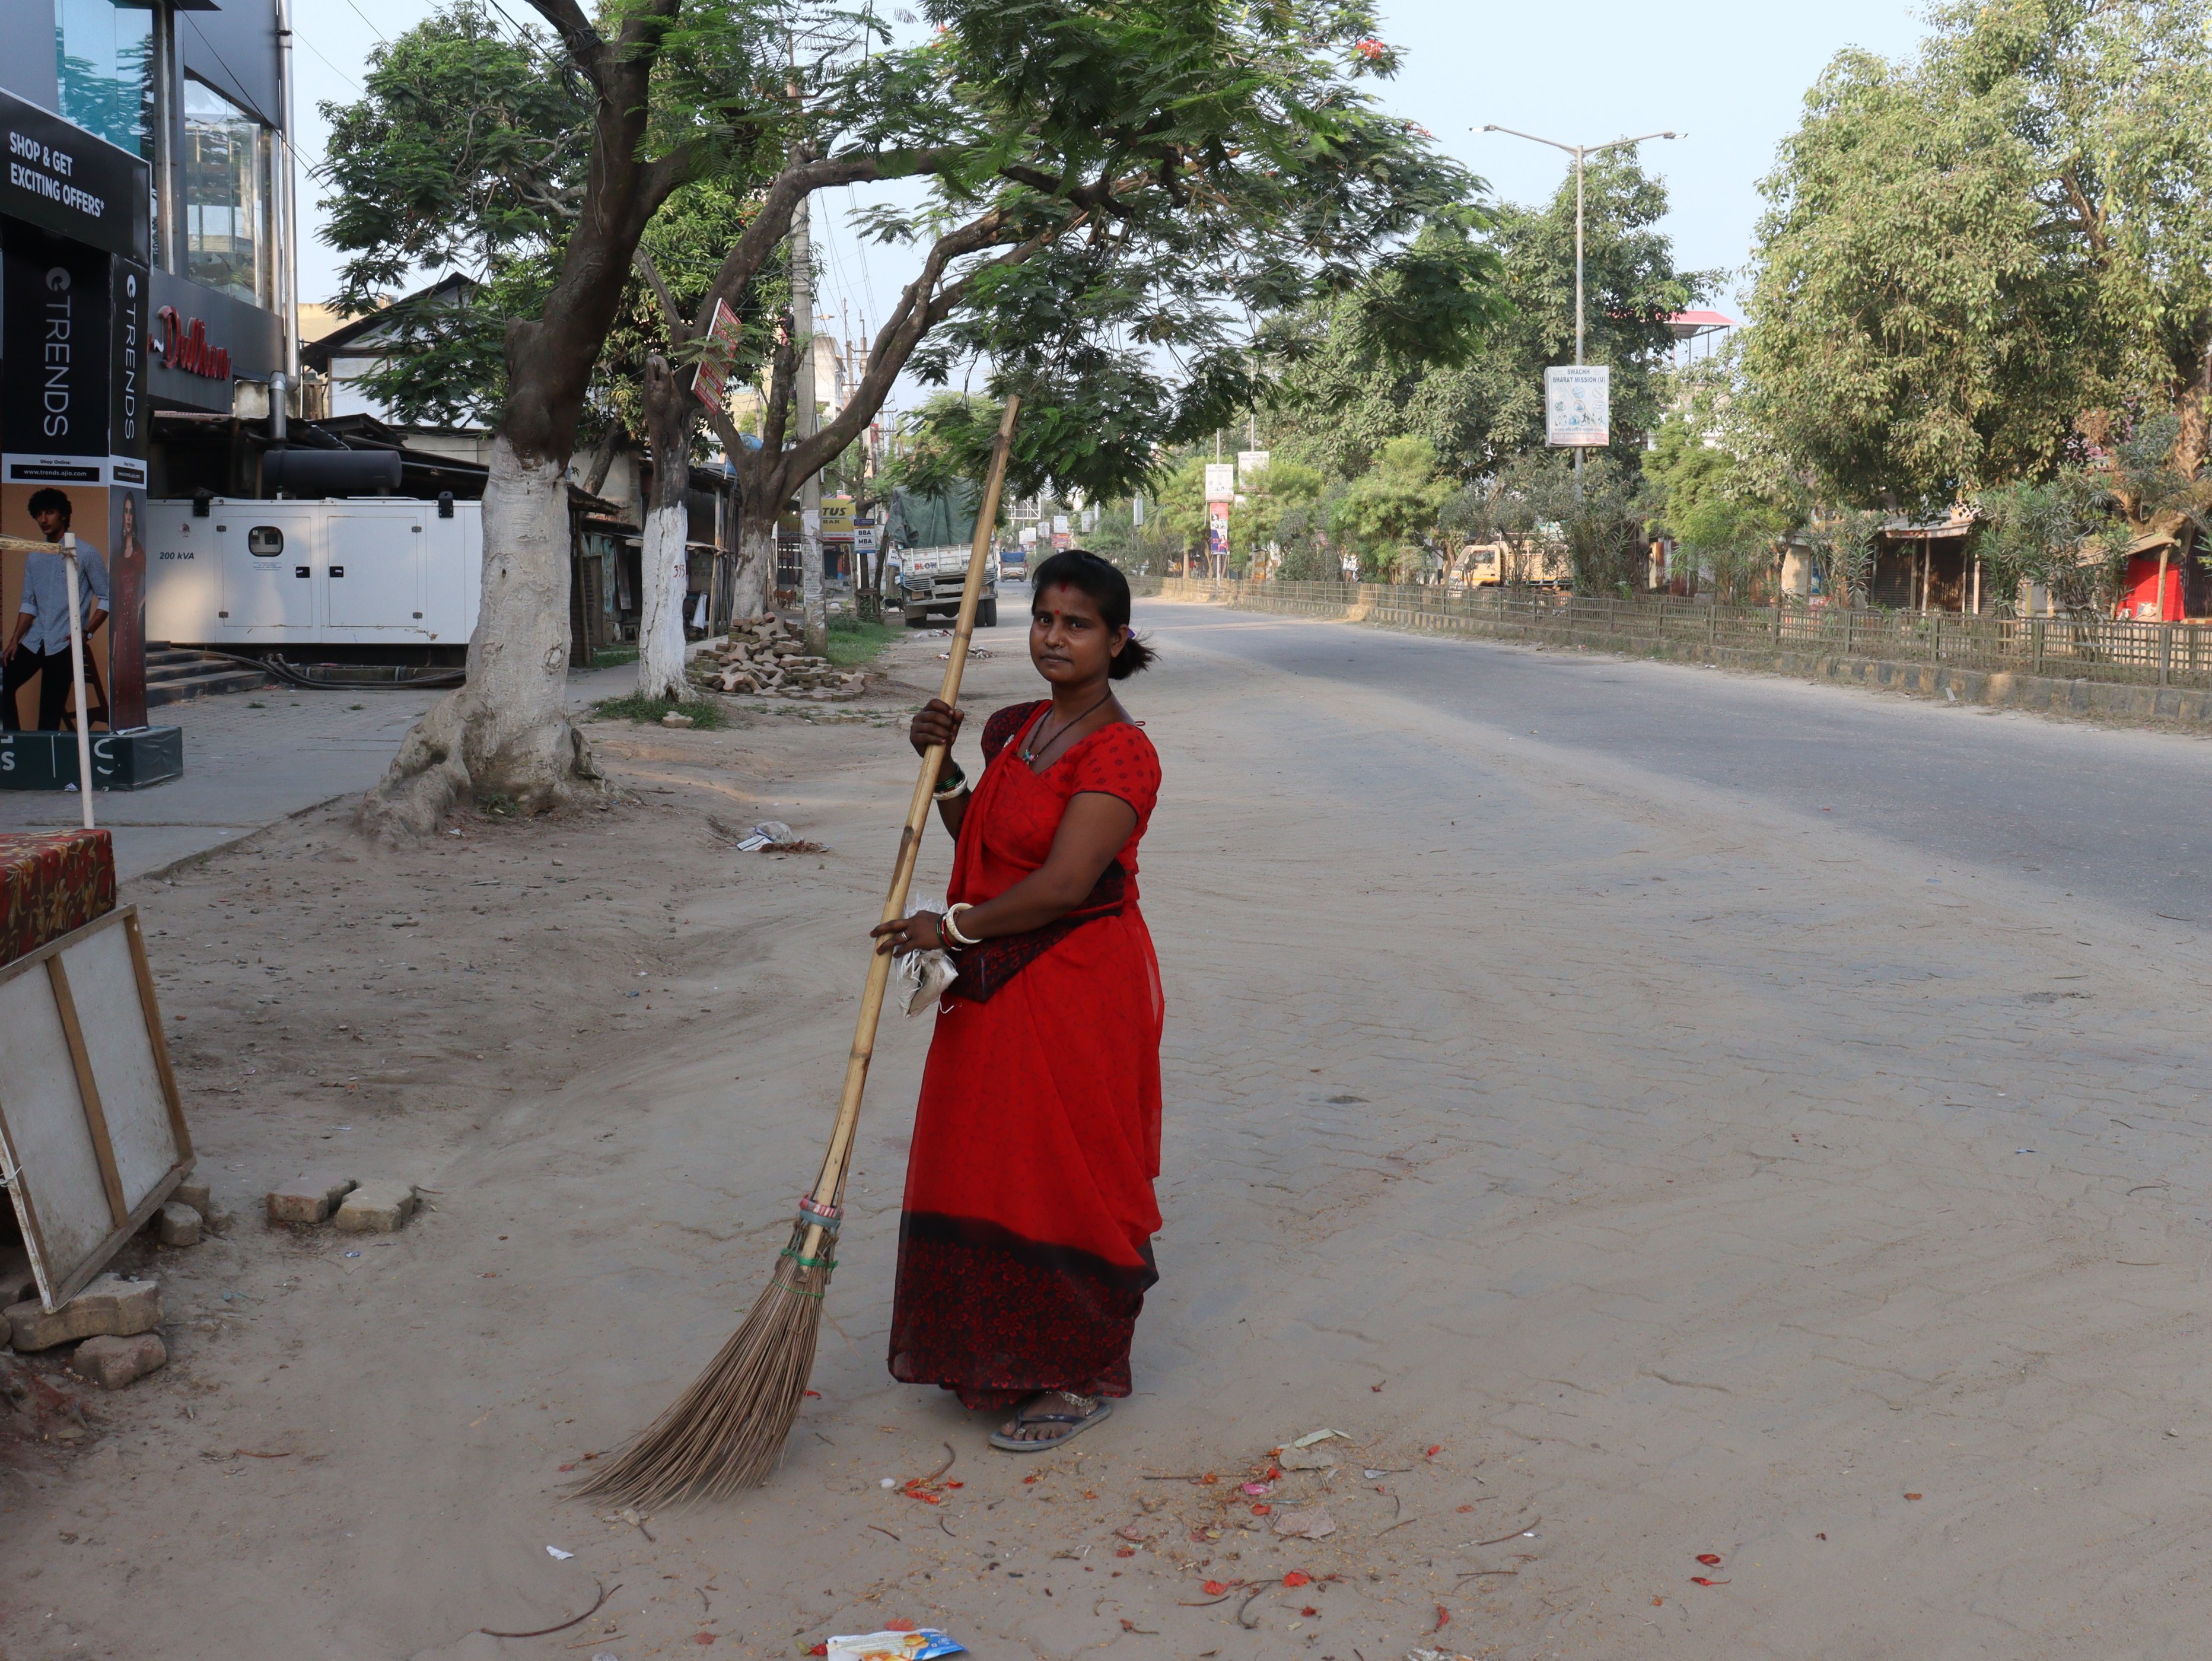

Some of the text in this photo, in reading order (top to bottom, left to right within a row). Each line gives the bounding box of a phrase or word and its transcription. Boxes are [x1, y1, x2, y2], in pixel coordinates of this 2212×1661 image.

[9, 131, 73, 177] SHOP & GET
[11, 162, 61, 201] EXCITING
[44, 295, 71, 436] TRENDS
[125, 303, 136, 439] TRENDS
[822, 507, 846, 516] TUS
[914, 562, 937, 570] BLOW
